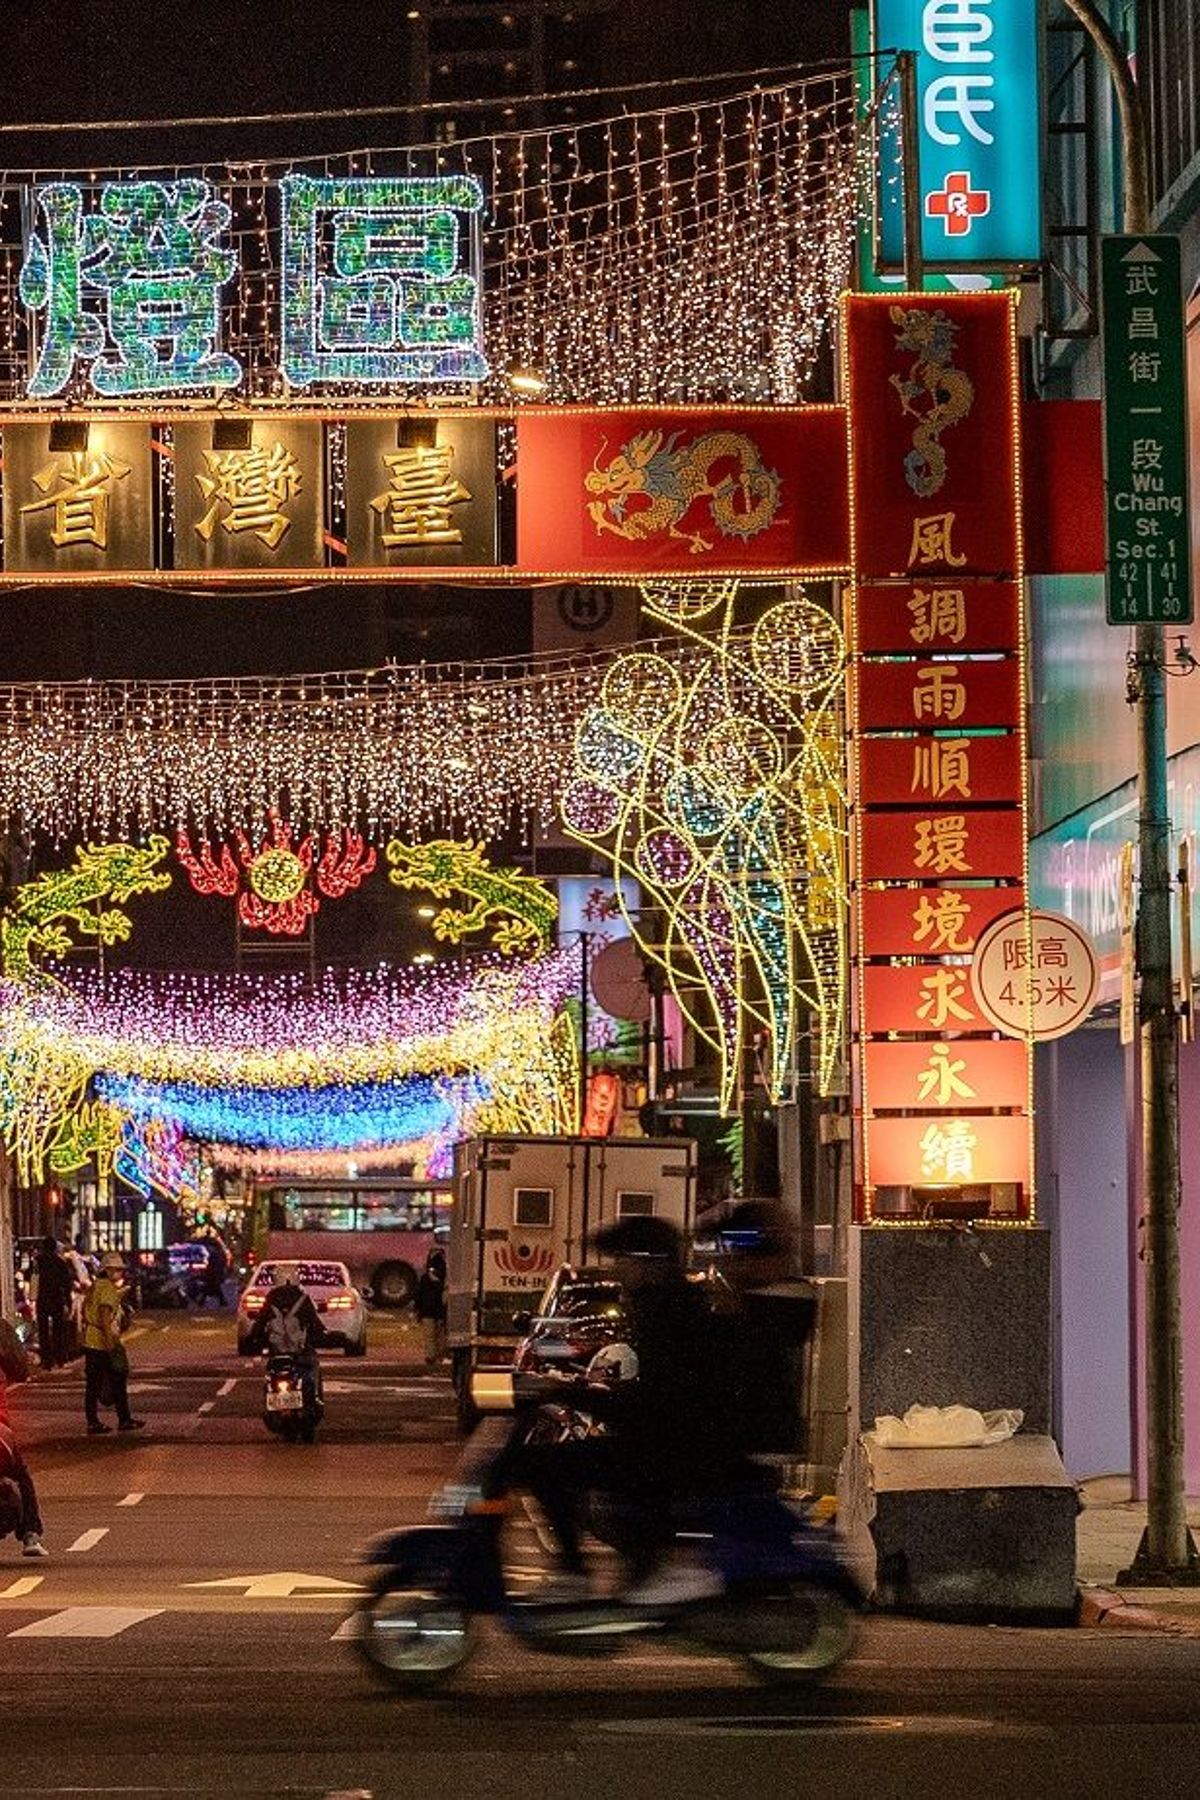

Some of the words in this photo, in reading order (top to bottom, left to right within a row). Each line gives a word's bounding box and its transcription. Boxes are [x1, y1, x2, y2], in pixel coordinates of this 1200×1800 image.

[1125, 264, 1163, 470] 武昌街一段
[1132, 473, 1164, 492] Wu
[1114, 492, 1183, 517] Chang
[908, 511, 977, 1183] 風調雨順環境求永續
[1003, 937, 1068, 969] 限高
[999, 976, 1078, 1007] 4.5米
